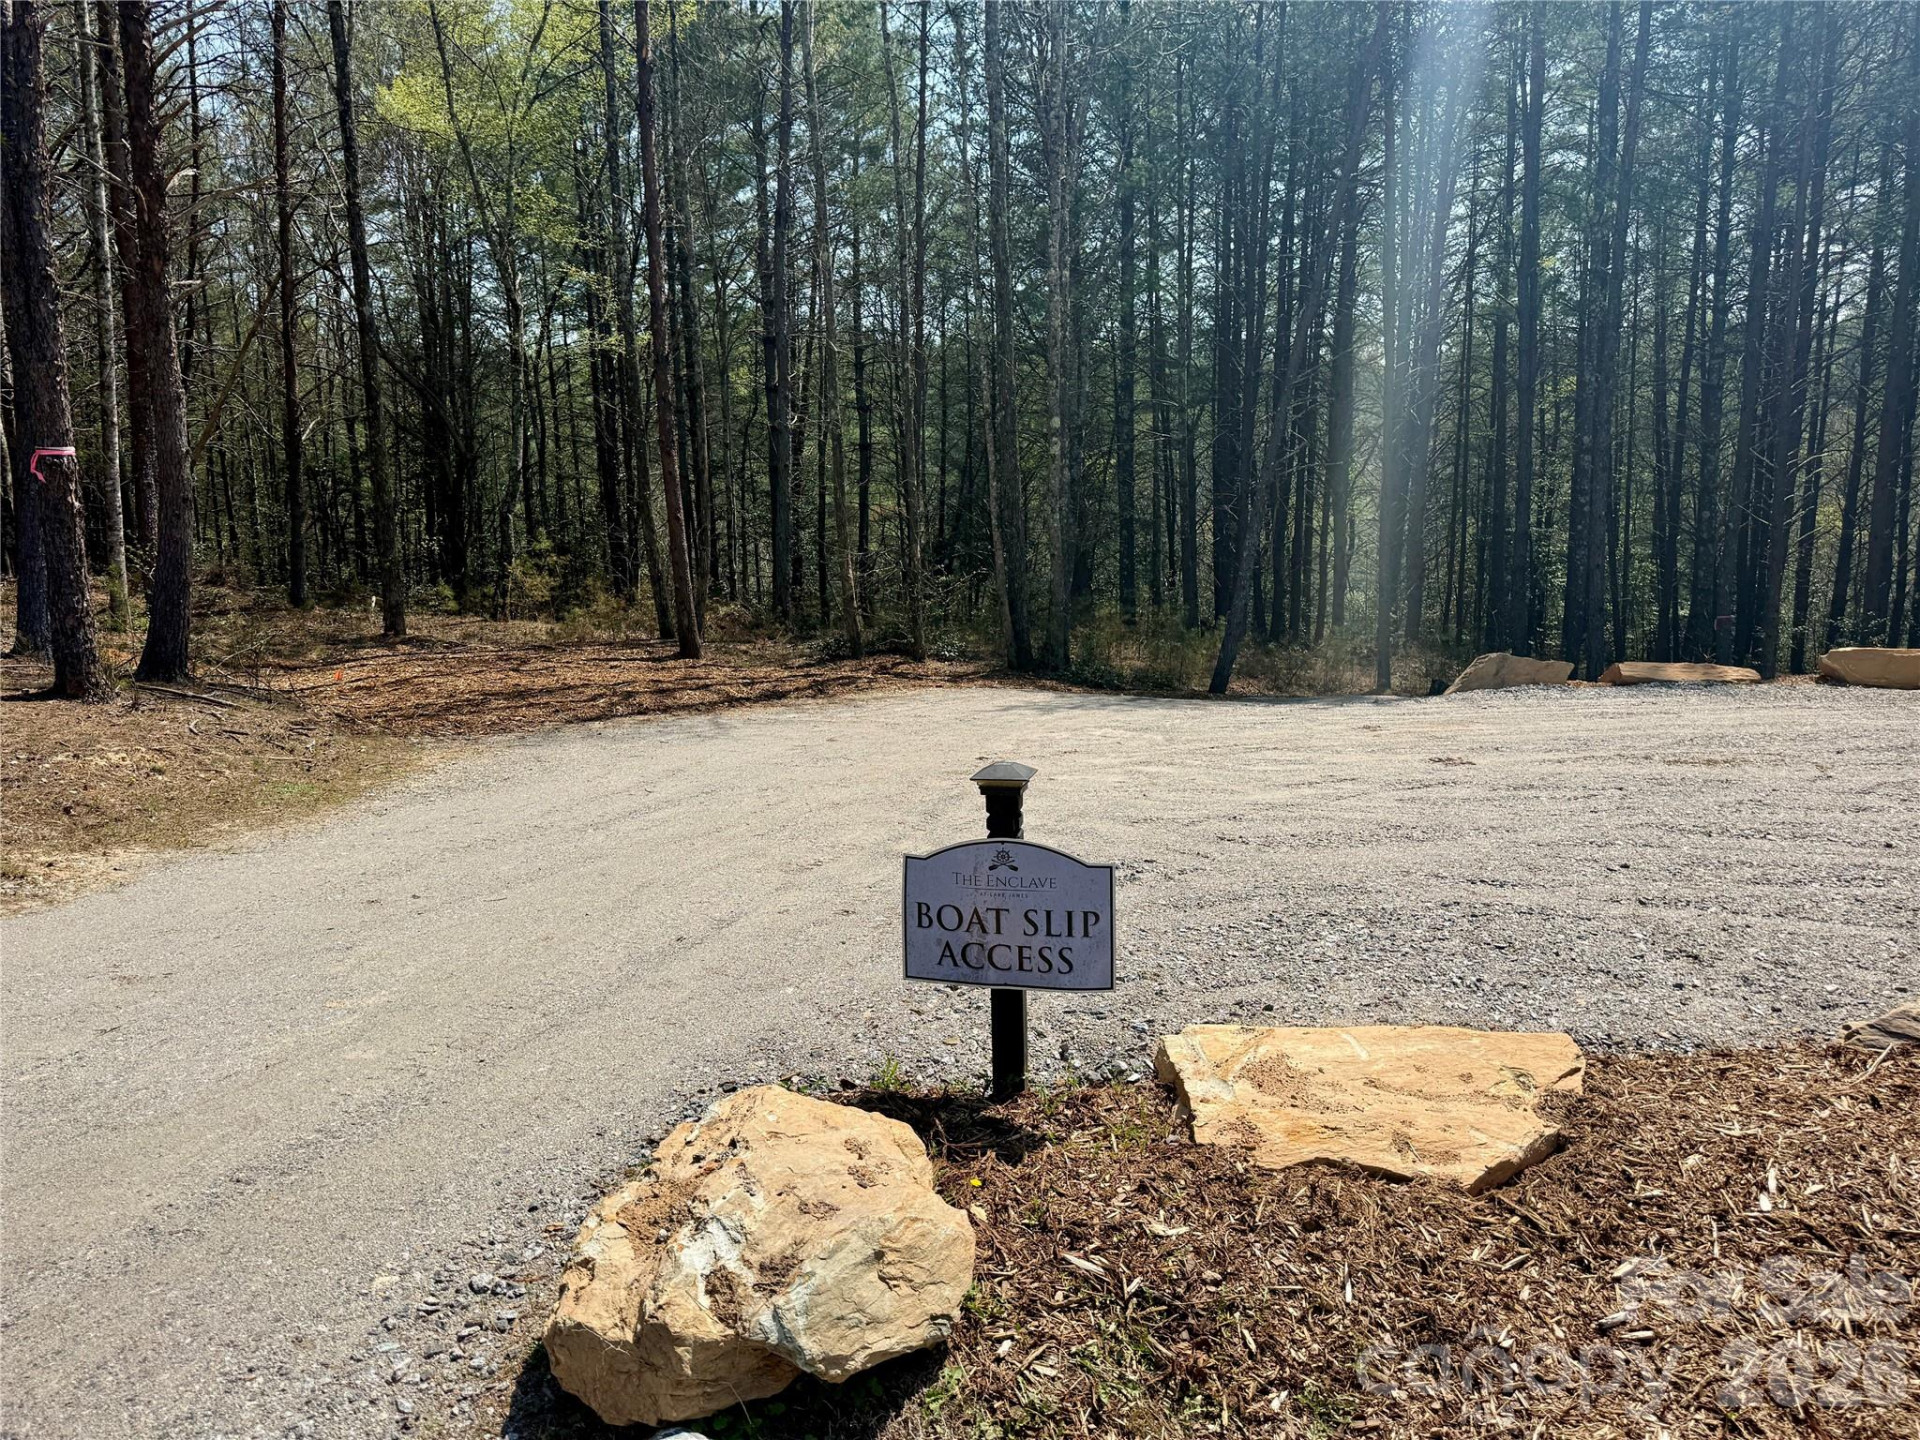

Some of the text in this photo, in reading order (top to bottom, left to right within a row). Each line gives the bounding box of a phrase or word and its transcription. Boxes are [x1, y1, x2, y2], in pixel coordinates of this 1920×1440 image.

[952, 872, 1058, 889] THE ENCLAVE
[916, 902, 1100, 938] BOAT SLIP
[936, 940, 1073, 975] ACCESS
